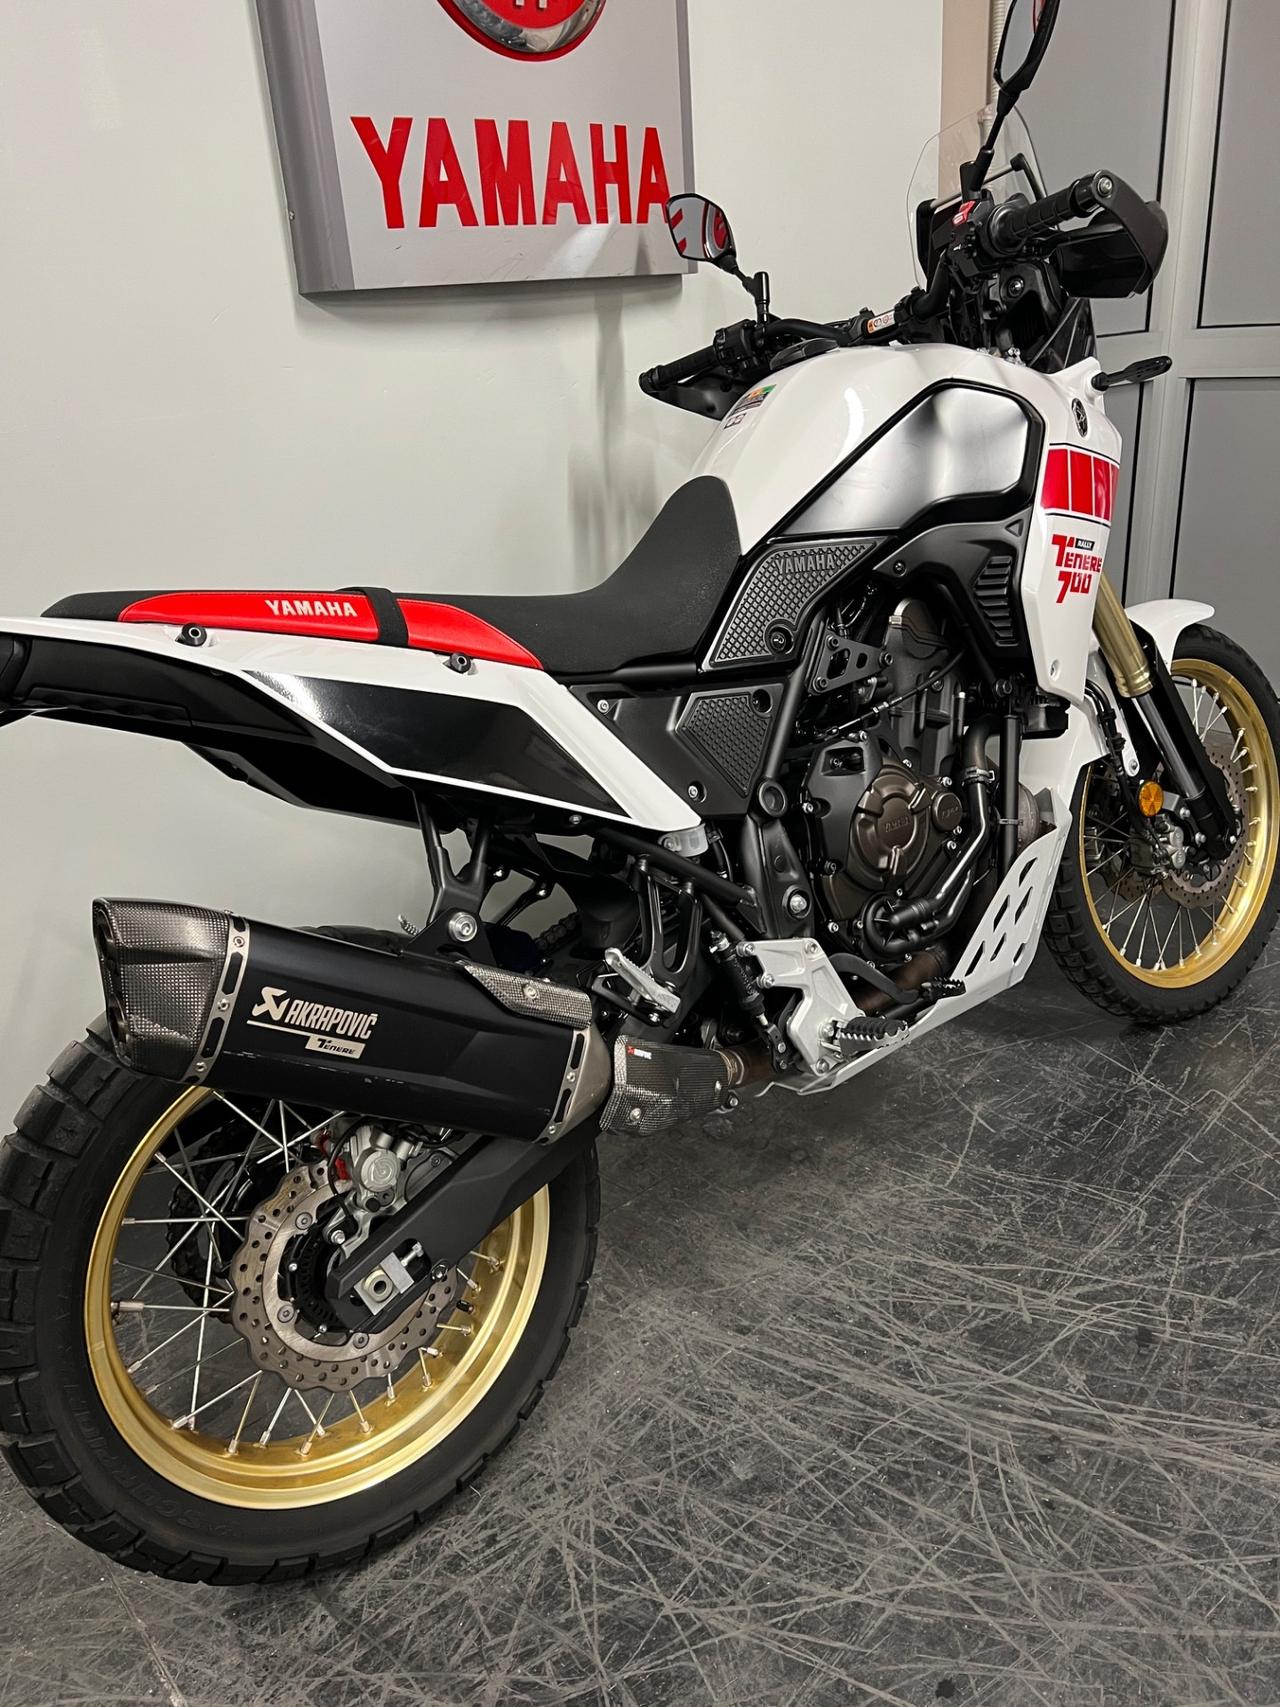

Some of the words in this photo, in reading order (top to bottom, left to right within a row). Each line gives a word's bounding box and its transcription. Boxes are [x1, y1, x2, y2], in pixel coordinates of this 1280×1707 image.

[350, 116, 671, 229] YAMAHA
[1076, 539, 1094, 549] RALLY
[775, 553, 835, 574] YAMAHA
[1056, 571, 1092, 604] 700
[264, 599, 358, 617] YAMAHA
